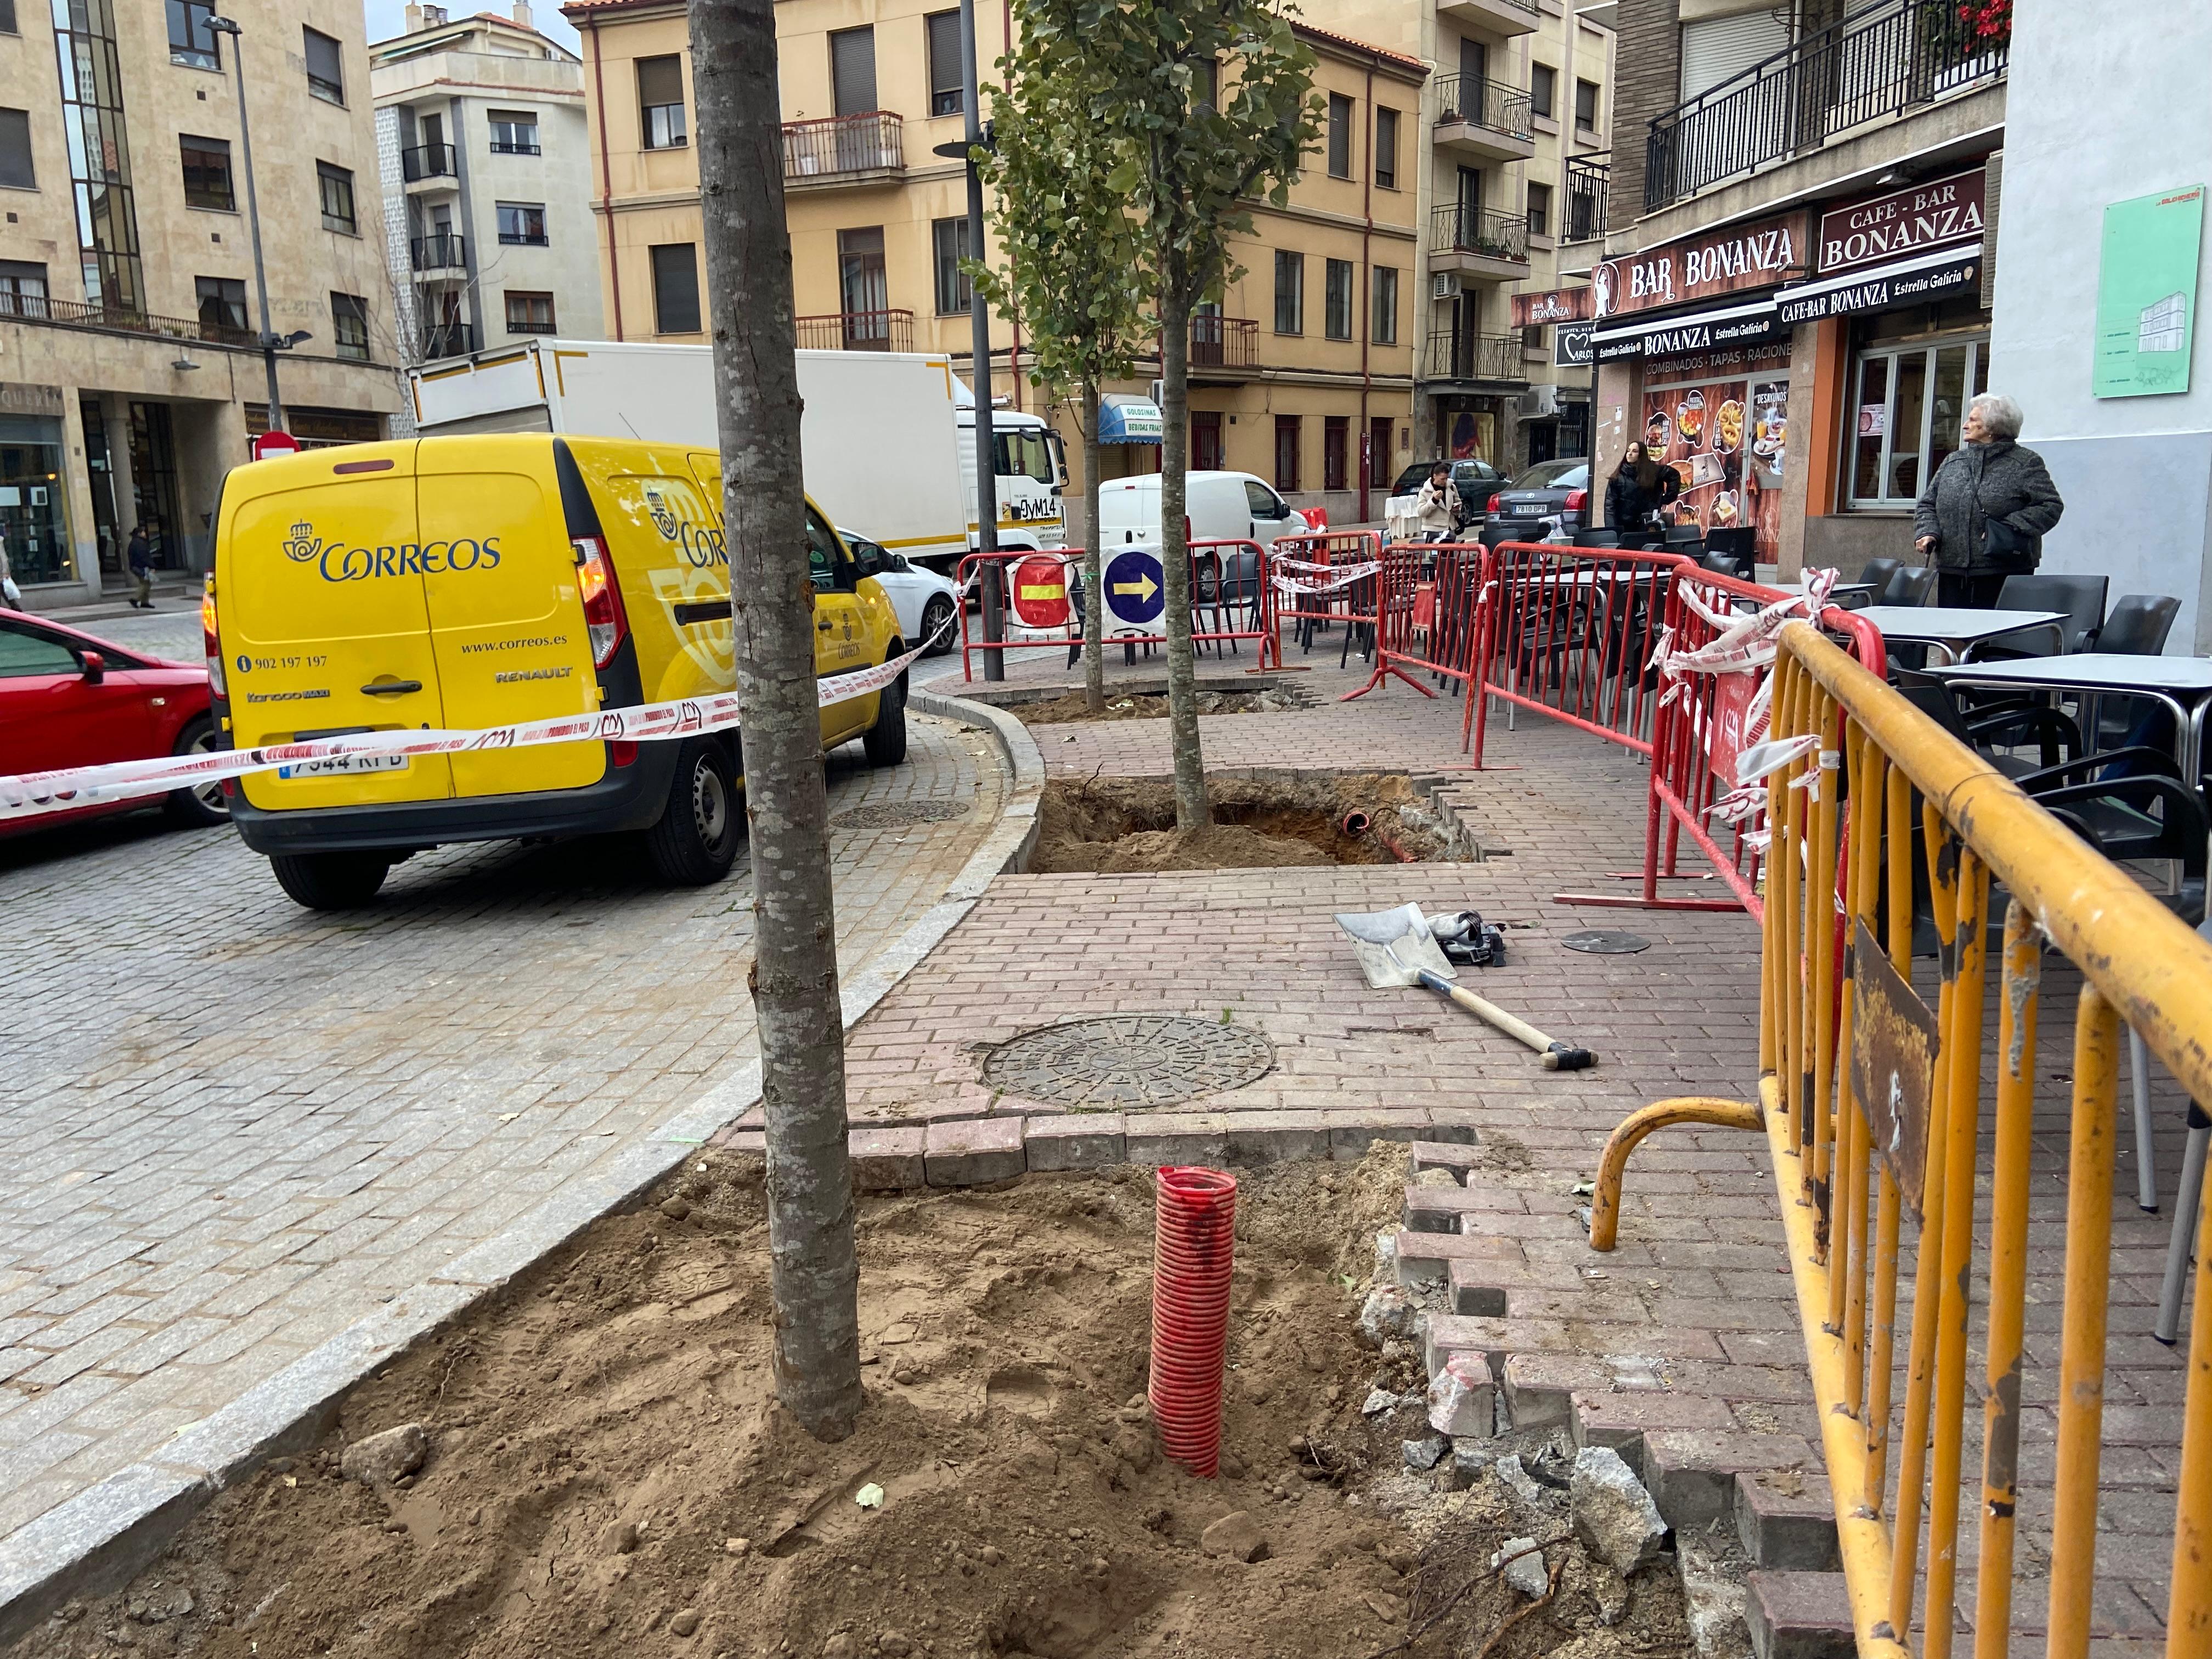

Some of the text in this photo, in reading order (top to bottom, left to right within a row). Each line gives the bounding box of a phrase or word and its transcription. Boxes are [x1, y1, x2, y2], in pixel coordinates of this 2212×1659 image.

[1849, 201, 1897, 229] CAFE
[1913, 185, 1956, 212] BAR
[1824, 201, 1984, 267] BONANZA
[1629, 228, 1795, 302] BAR BONANZA
[1781, 269, 1962, 323] CAFE-BAR BONANZA Estrella Galicia
[1532, 307, 1570, 320] BONANZA
[1599, 323, 1763, 358] Estrella Galicia BONANZA Estrella Galicia
[1646, 357, 1703, 376] COMBINADOS
[1710, 352, 1741, 367] TAPAS
[1757, 391, 1787, 404] DESAYUNOS
[1127, 408, 1156, 416] GOLOSINAS
[1128, 423, 1148, 431] BEBIDAS
[681, 520, 729, 568] COR
[319, 537, 501, 583] CORREOS
[461, 634, 568, 654] www.correos.es
[838, 641, 860, 660] CORREOS
[255, 655, 328, 670] 902 197 197
[495, 666, 573, 684] RENAULT
